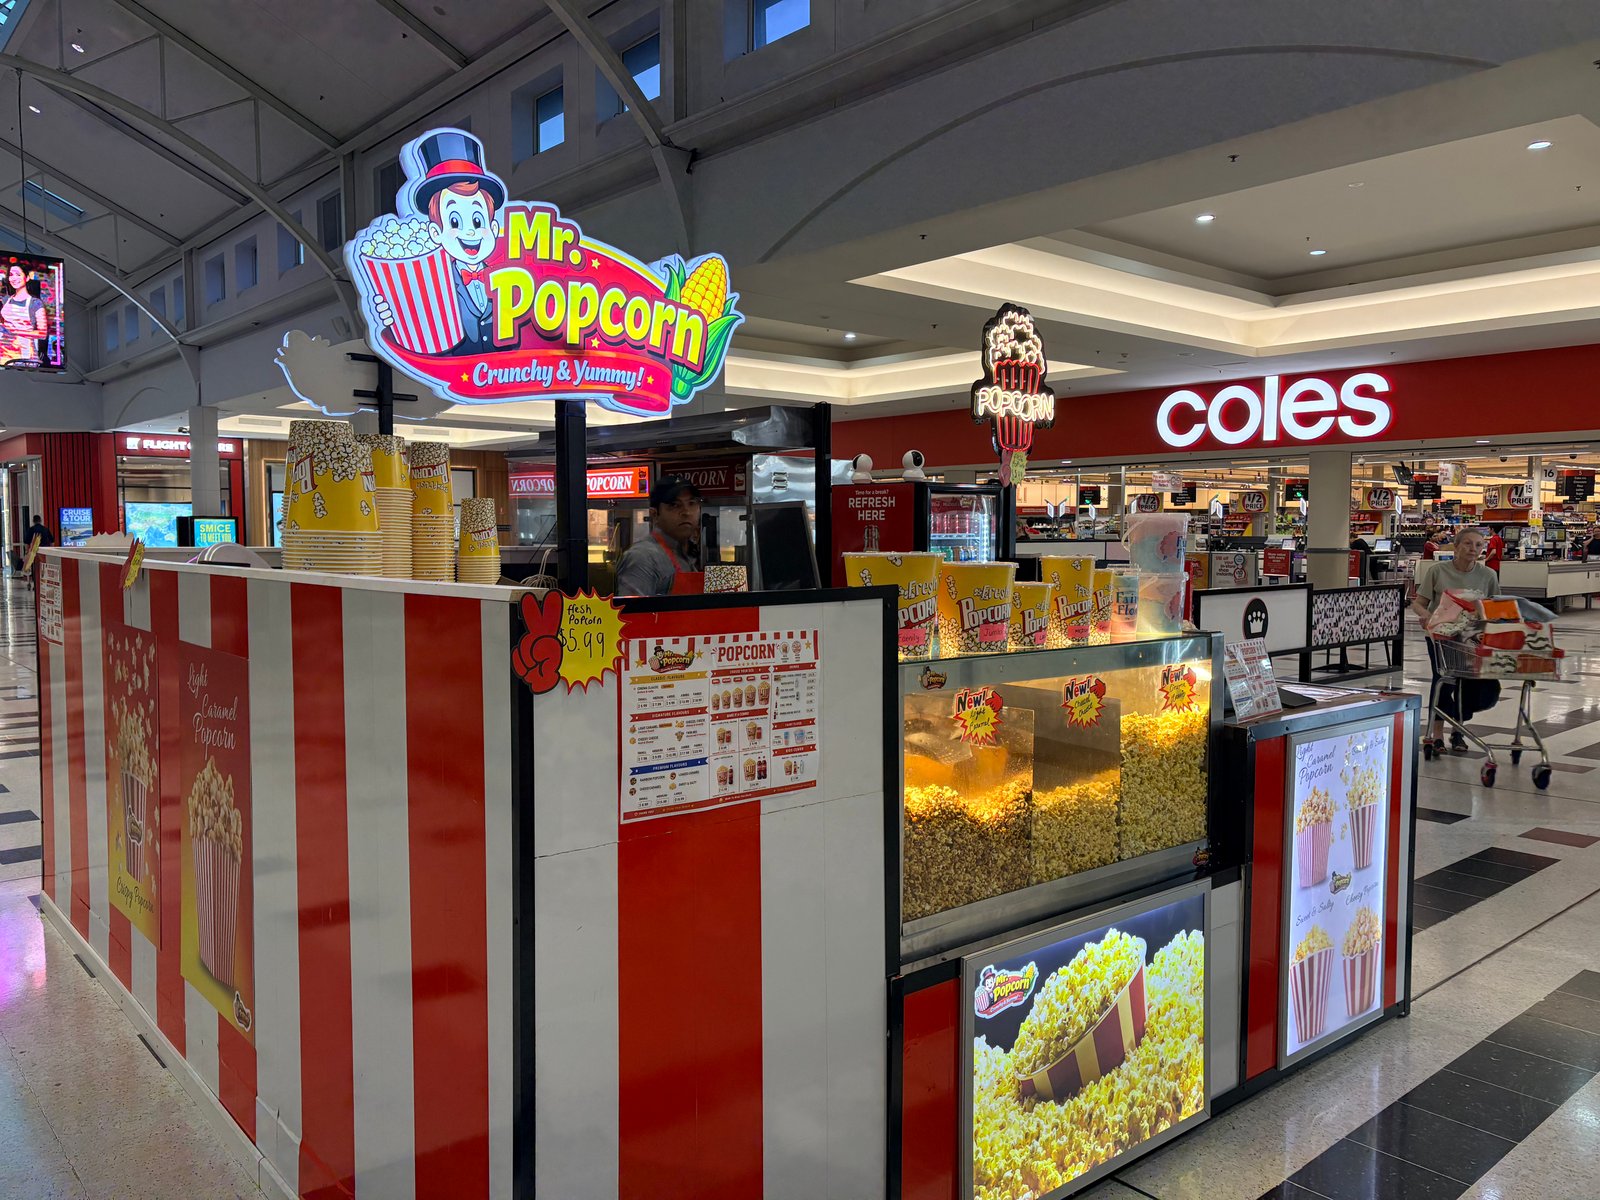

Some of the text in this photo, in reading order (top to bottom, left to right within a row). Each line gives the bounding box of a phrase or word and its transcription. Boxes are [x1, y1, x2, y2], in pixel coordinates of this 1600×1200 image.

[508, 212, 581, 265] Mr.
[491, 268, 703, 366] Popcorn
[473, 359, 645, 389] Crunchy & Yummy!
[975, 385, 1054, 422] POPCORN
[1157, 372, 1390, 447] coles
[143, 440, 187, 451] FLIGHT
[1544, 469, 1554, 477] 16
[1142, 496, 1156, 504] 1/2
[1247, 494, 1262, 503] 1/2
[1372, 489, 1389, 500] 1/2
[1525, 485, 1532, 493] 15
[848, 496, 896, 508] REFRESH
[857, 510, 885, 520] HERE
[1116, 592, 1137, 604] Fair
[898, 595, 938, 629] PCORN
[957, 597, 1010, 632] POPCORN
[1117, 604, 1137, 616] Flo
[560, 628, 604, 658] $5.99
[718, 643, 775, 662] POPCORN
[662, 657, 690, 666] Popcorn
[187, 662, 208, 699] Light
[1163, 667, 1184, 687] New!
[958, 690, 986, 712] New!
[1066, 679, 1090, 701] New!
[202, 694, 238, 720] Caramel
[193, 712, 236, 761] Popcorn
[1307, 745, 1336, 768] Caramel
[1299, 763, 1333, 789] Popcorn
[133, 885, 154, 914] Popcorn
[1296, 912, 1311, 926] Sweet
[993, 978, 1030, 1002] Popcorn
[996, 974, 1008, 986] Mr.
